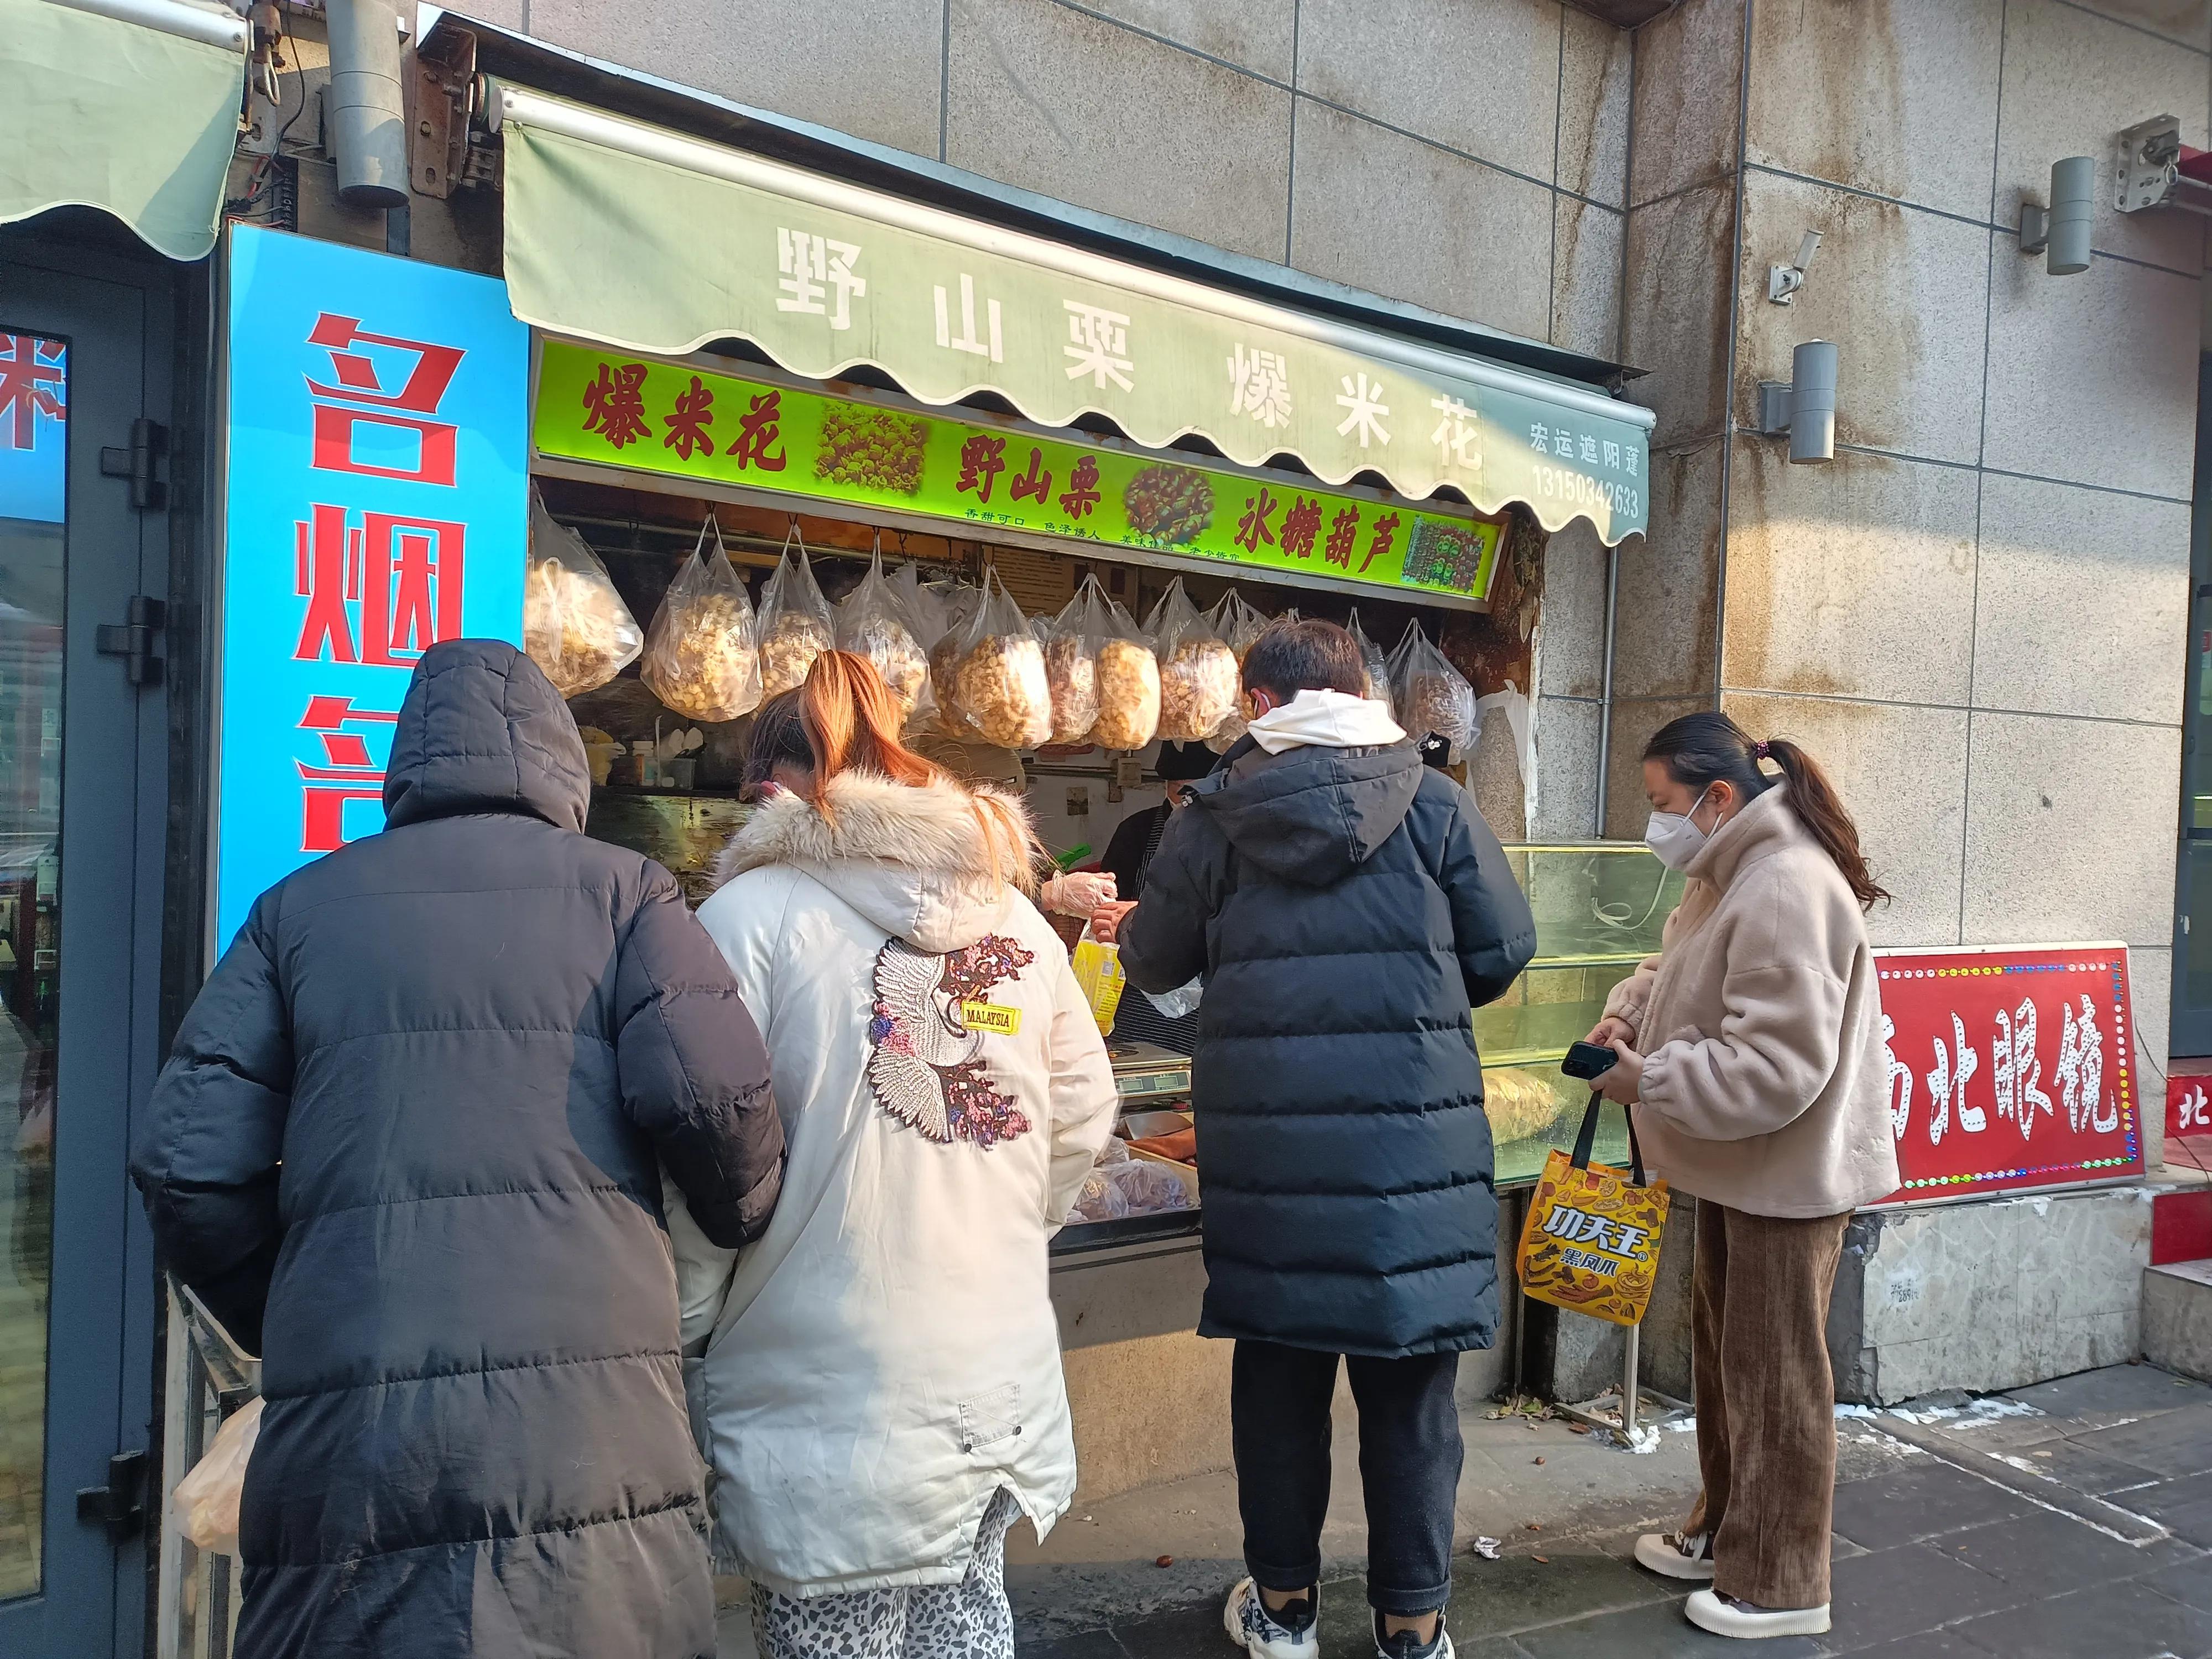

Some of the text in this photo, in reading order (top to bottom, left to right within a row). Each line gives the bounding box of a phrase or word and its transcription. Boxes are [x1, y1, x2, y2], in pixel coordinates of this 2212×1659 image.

[775, 226, 1483, 471] 野山栗 爆米花
[582, 363, 1401, 573] 爆米花 野山栗 冰糖葫芦
[1532, 465, 1639, 519] 13150342633
[964, 508, 1025, 527] 香甜可口
[1044, 521, 1101, 541] 色泽诱人
[1120, 534, 1174, 552] 美味佳品
[966, 1008, 1010, 1029] MALAYSIA
[2179, 1084, 2210, 1129] 北
[1542, 1203, 1650, 1259] 功夫王
